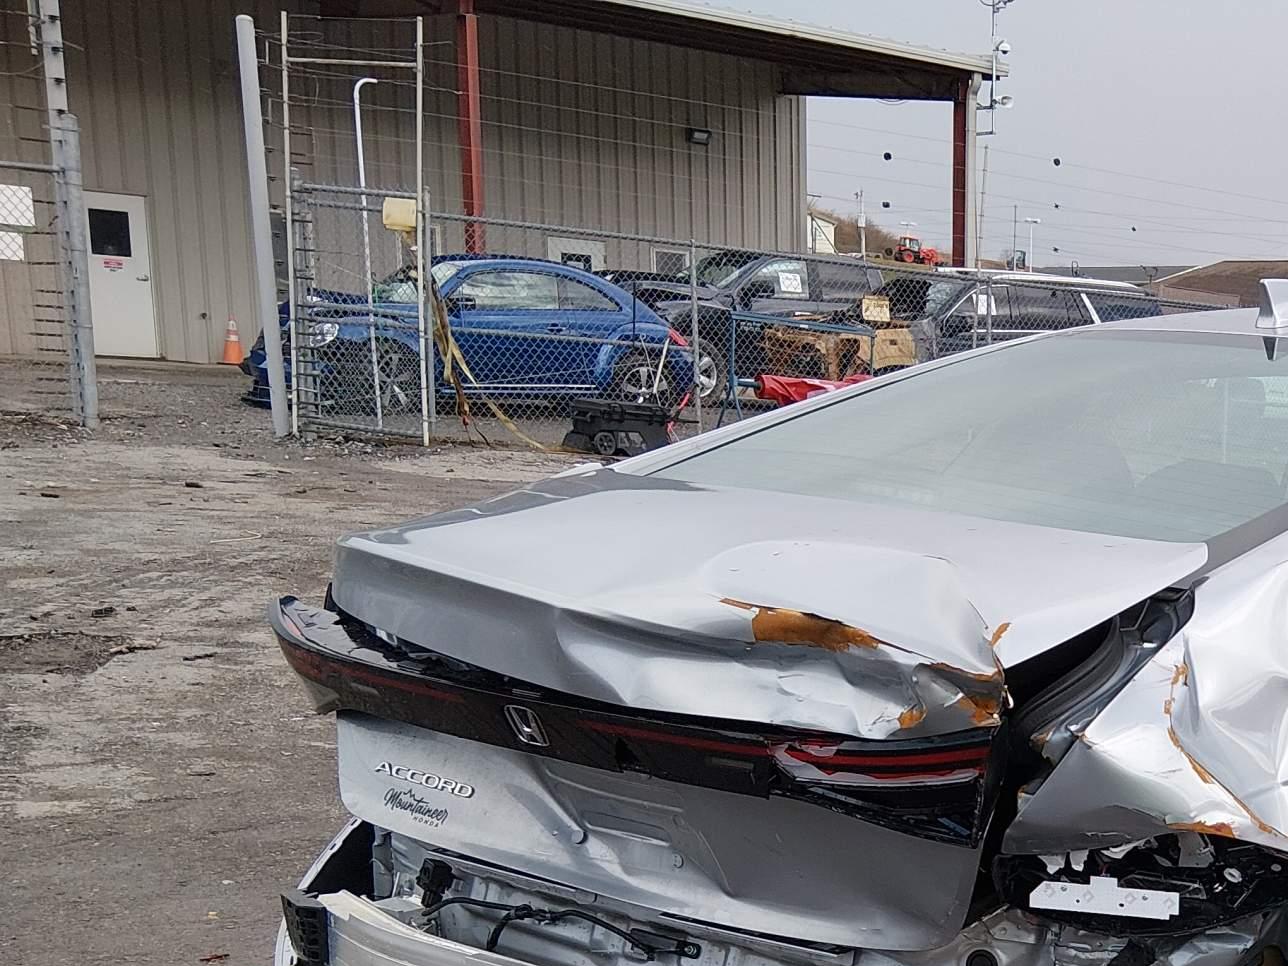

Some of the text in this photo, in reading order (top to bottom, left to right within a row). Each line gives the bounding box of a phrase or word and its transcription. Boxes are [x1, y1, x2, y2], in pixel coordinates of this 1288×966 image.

[375, 761, 475, 798] ACCORD
[383, 788, 449, 825] Mountaineer
[413, 816, 440, 828] HONDA
